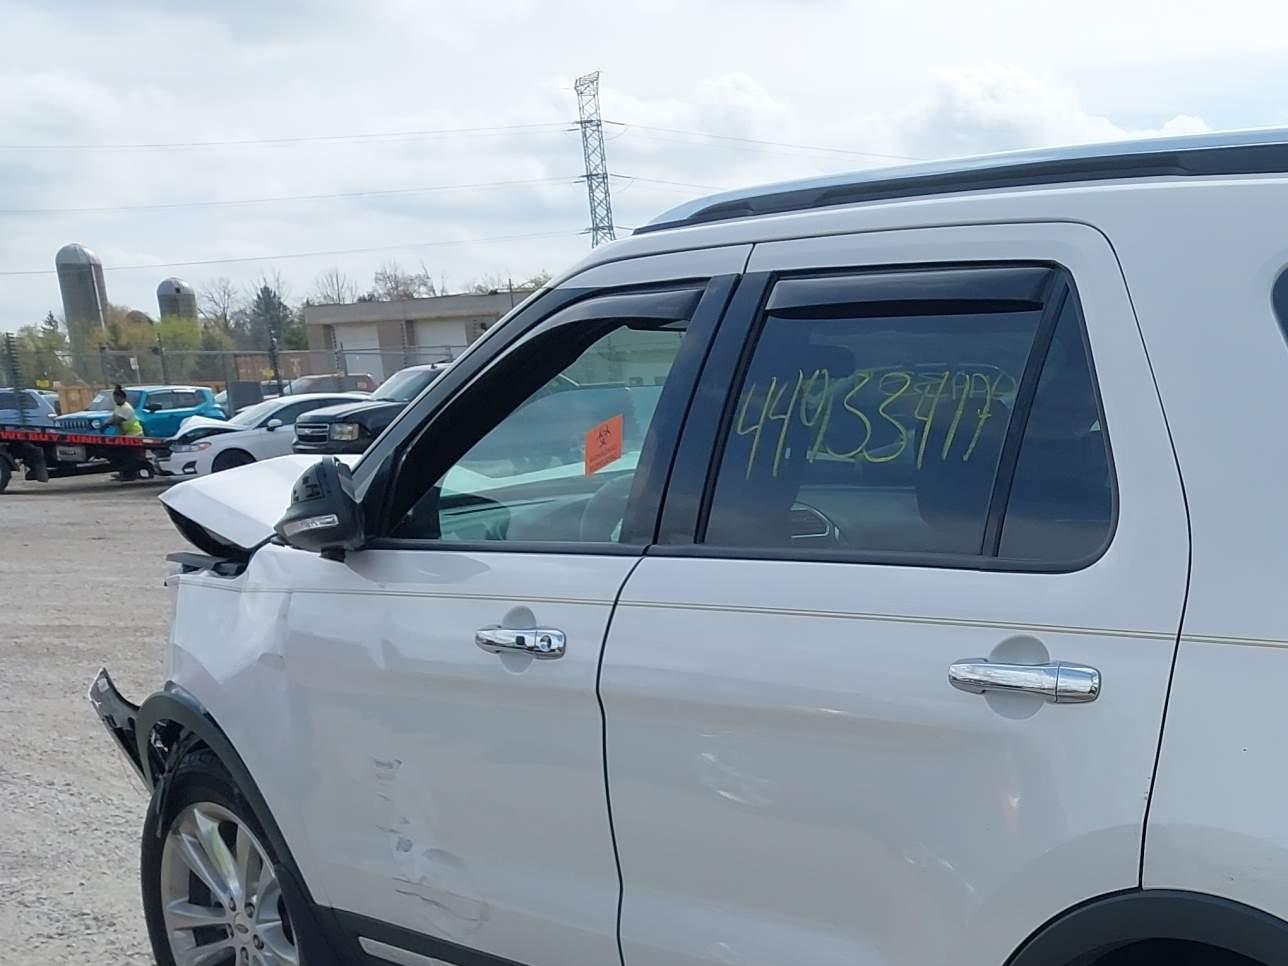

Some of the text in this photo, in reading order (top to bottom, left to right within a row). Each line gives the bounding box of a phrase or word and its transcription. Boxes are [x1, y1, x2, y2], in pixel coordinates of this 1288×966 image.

[1, 431, 143, 446] WE BUY JUNK CARS
